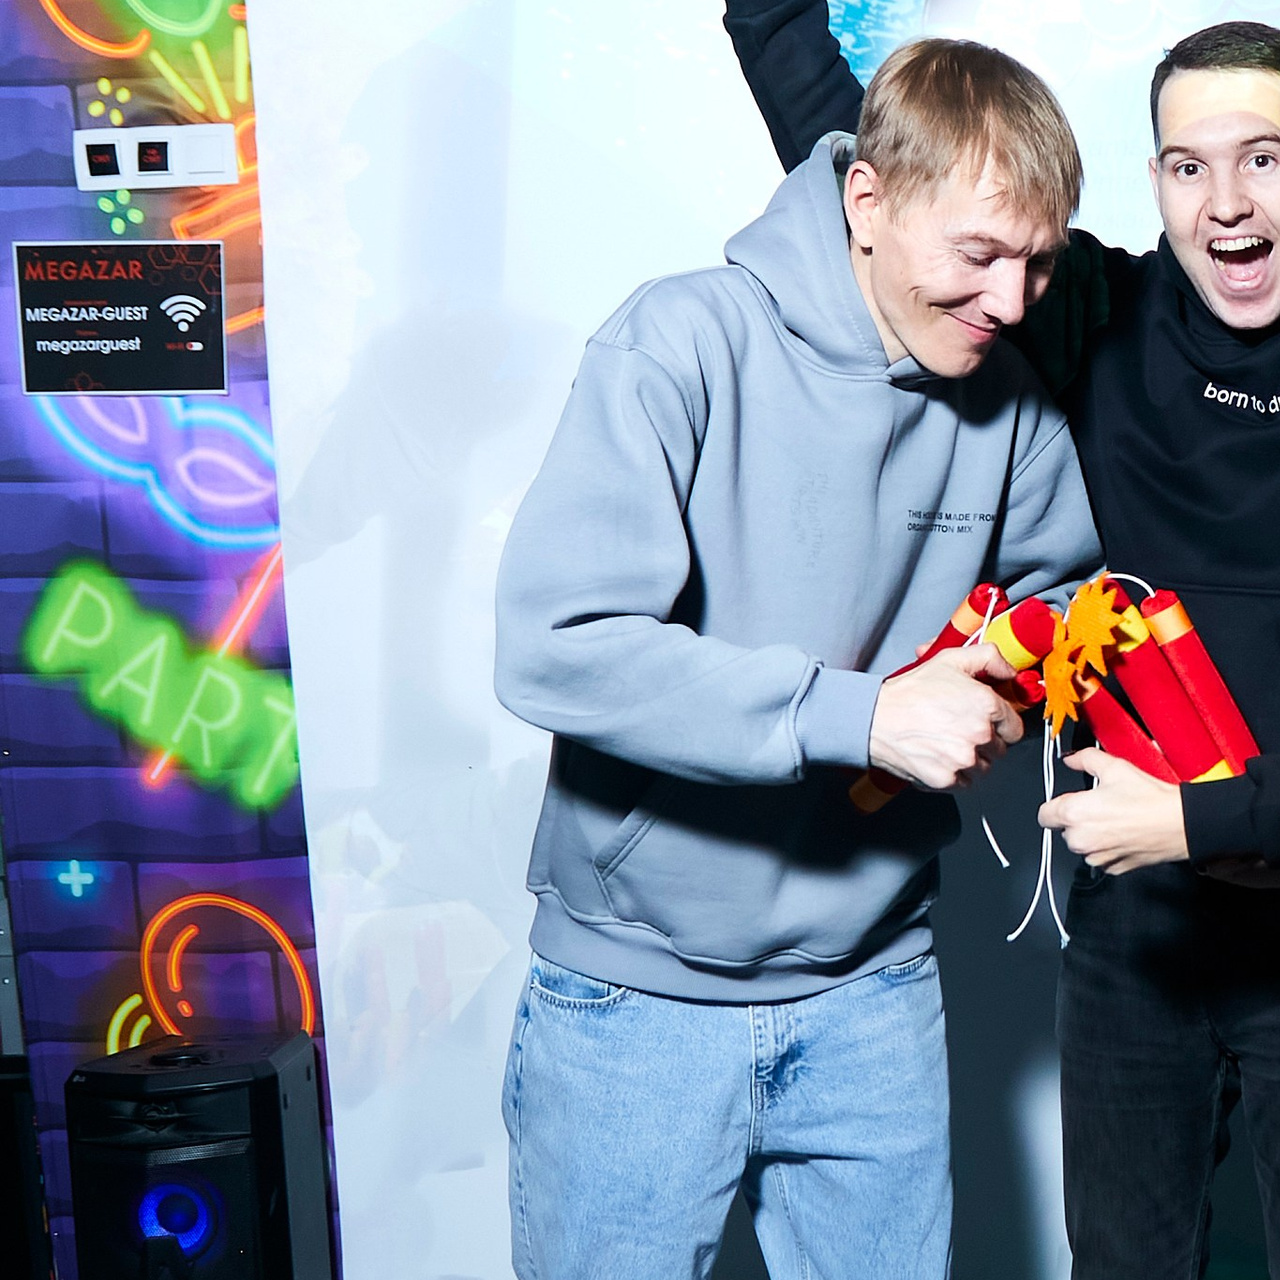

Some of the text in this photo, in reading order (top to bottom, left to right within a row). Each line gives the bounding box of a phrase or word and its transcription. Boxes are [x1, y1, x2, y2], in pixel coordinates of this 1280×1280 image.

[24, 259, 145, 281] MEGAZAR
[25, 305, 149, 322] MEGAZAR-GUEST
[36, 336, 142, 355] megazarguest
[1203, 381, 1249, 409] born
[1250, 395, 1266, 413] to
[945, 512, 970, 522] MADE
[957, 525, 974, 534] MIX
